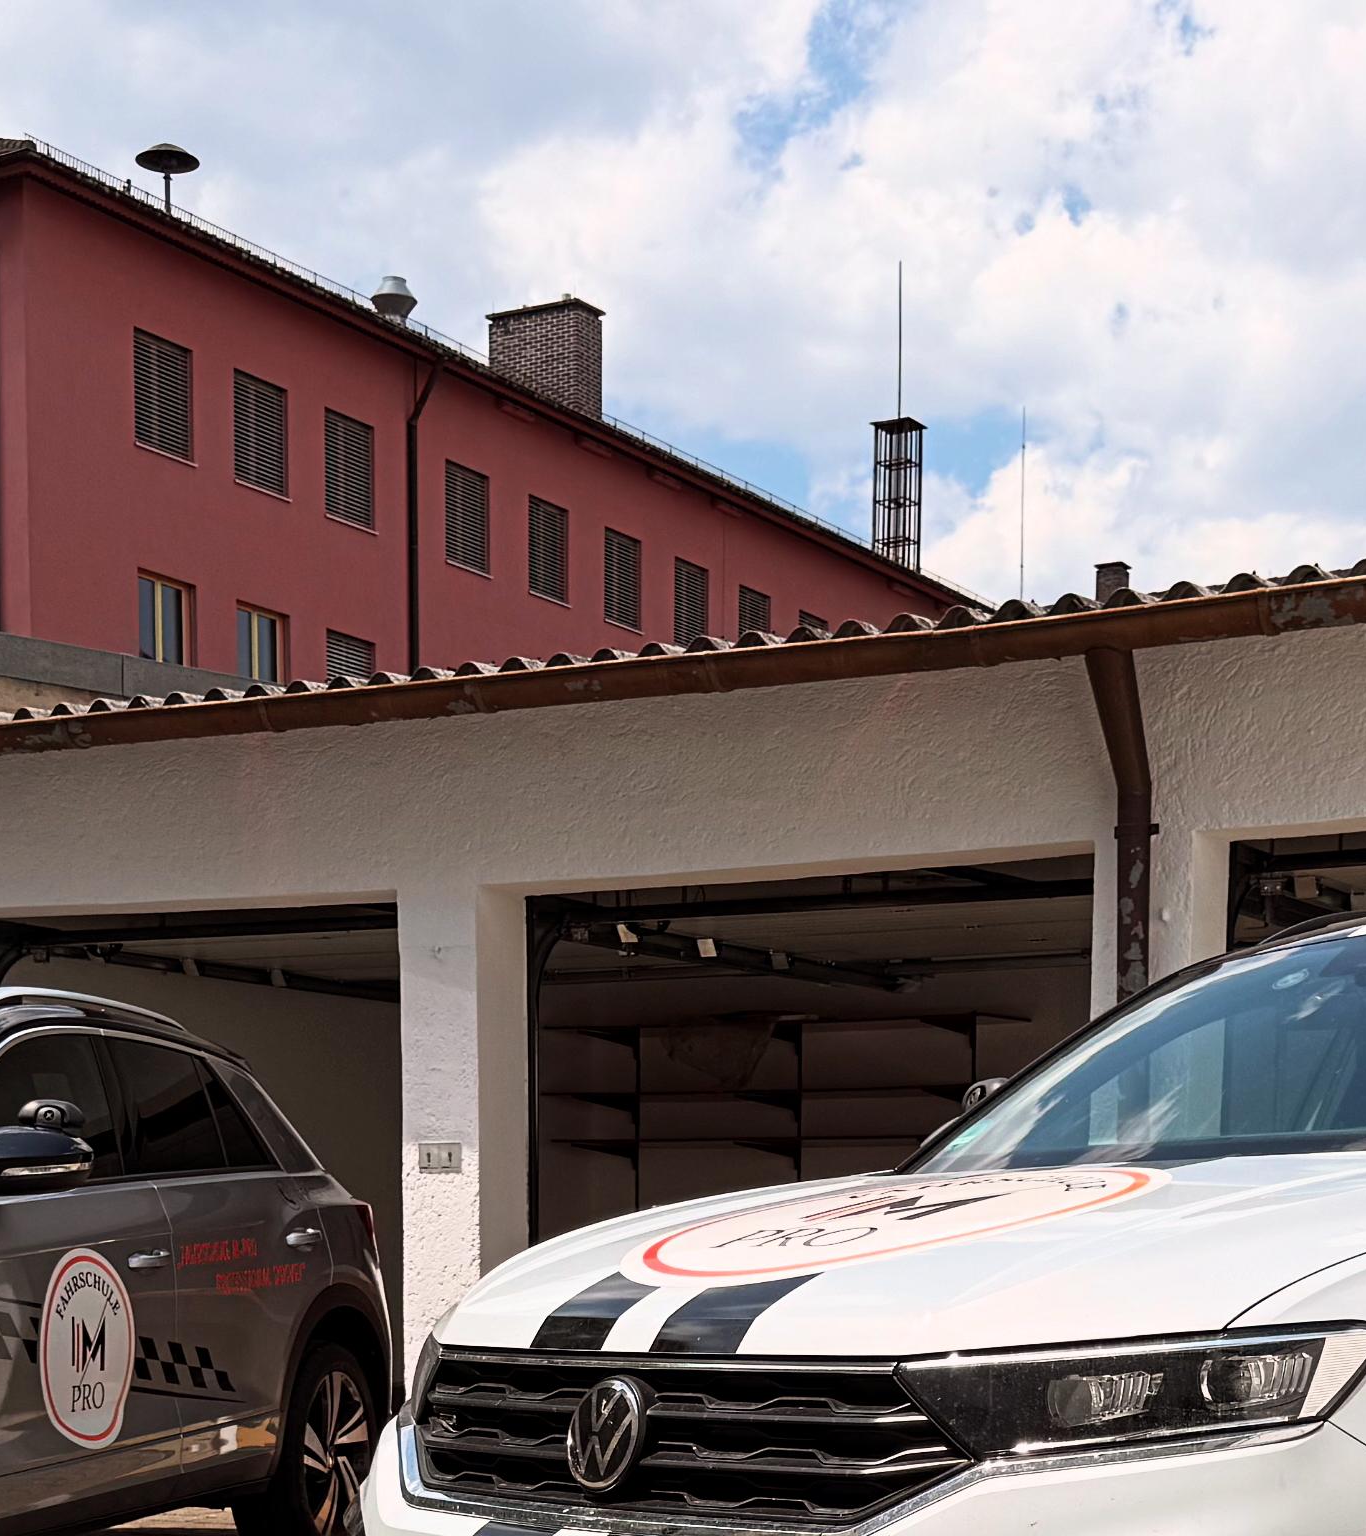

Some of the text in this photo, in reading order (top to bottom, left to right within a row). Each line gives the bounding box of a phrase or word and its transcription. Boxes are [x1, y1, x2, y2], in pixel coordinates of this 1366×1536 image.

[710, 1226, 879, 1249] PRO
[55, 1271, 121, 1321] FAHRSCHULE
[70, 1381, 105, 1413] PRO
